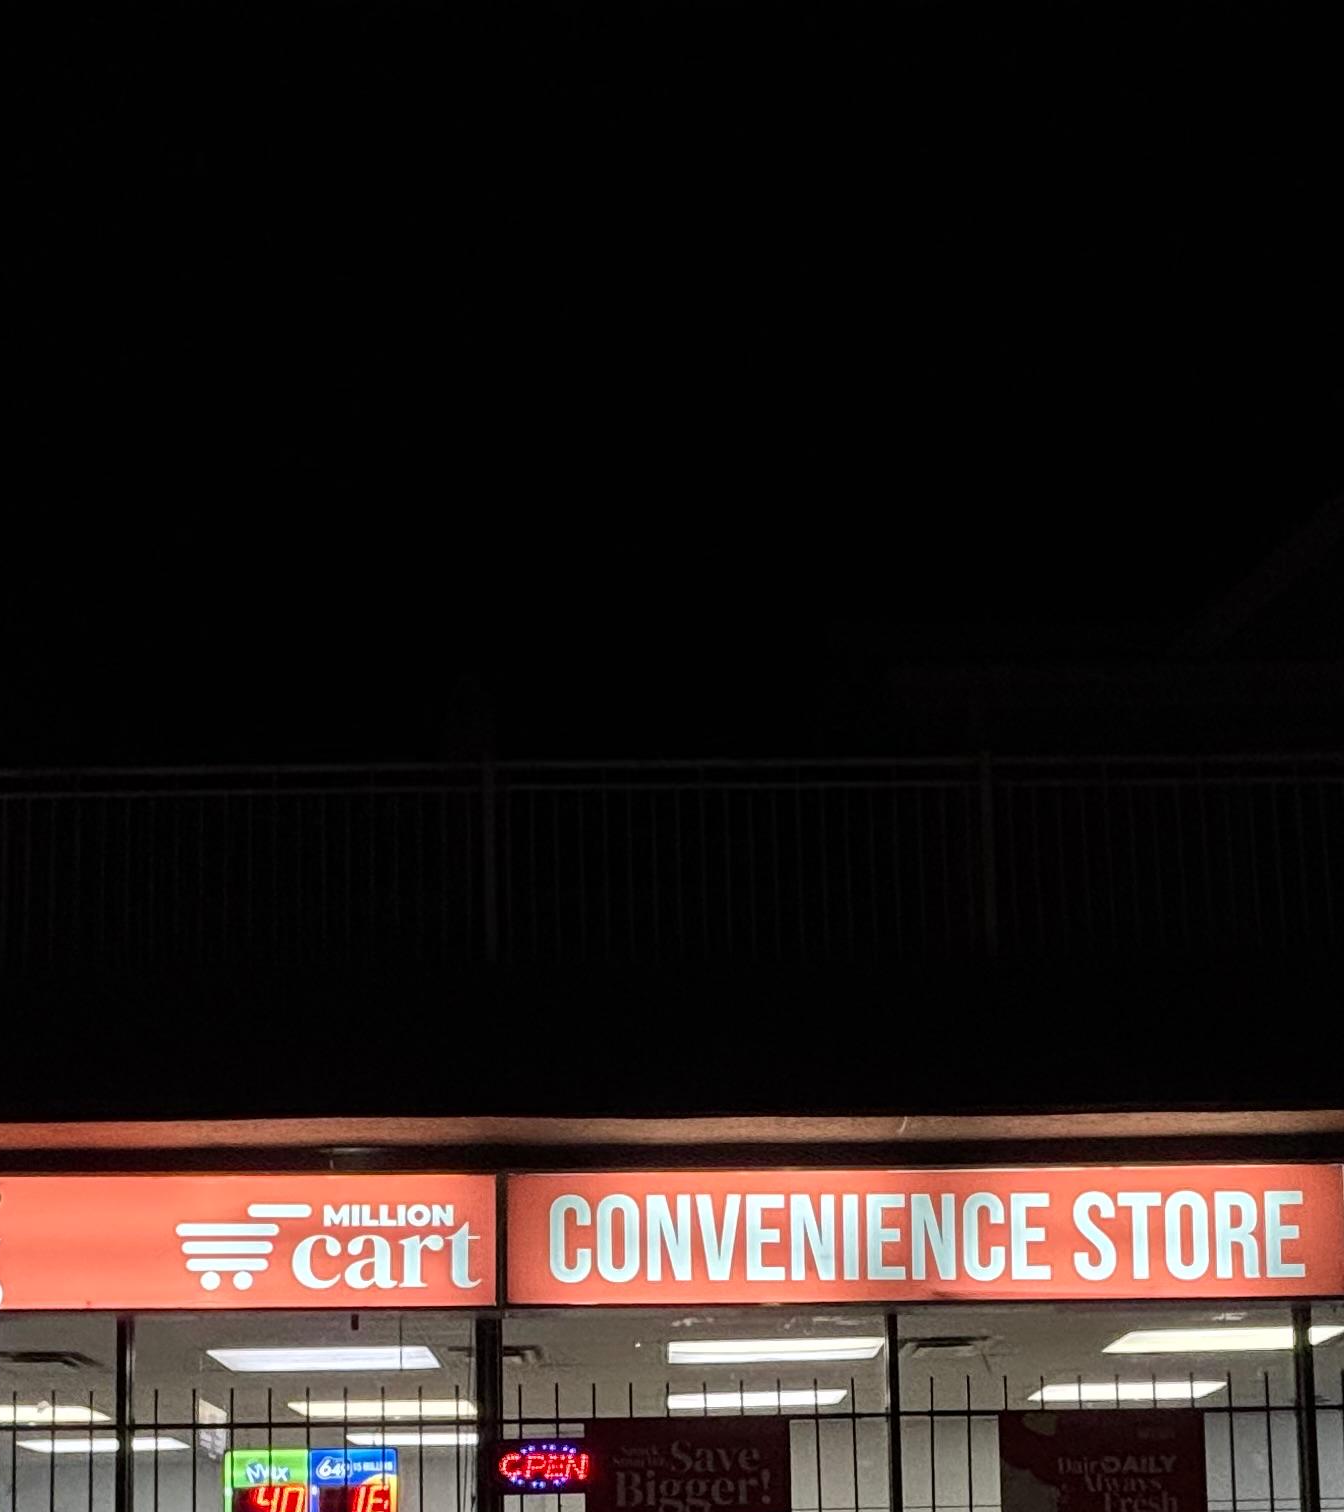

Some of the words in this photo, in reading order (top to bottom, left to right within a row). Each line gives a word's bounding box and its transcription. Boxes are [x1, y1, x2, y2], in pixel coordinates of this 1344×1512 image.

[323, 1204, 454, 1227] MILLION
[548, 1192, 1053, 1284] CONVENIENCE
[1072, 1189, 1307, 1281] STORE
[291, 1220, 483, 1290] cart
[670, 1439, 760, 1473] Save
[1102, 1455, 1177, 1474] DAILY
